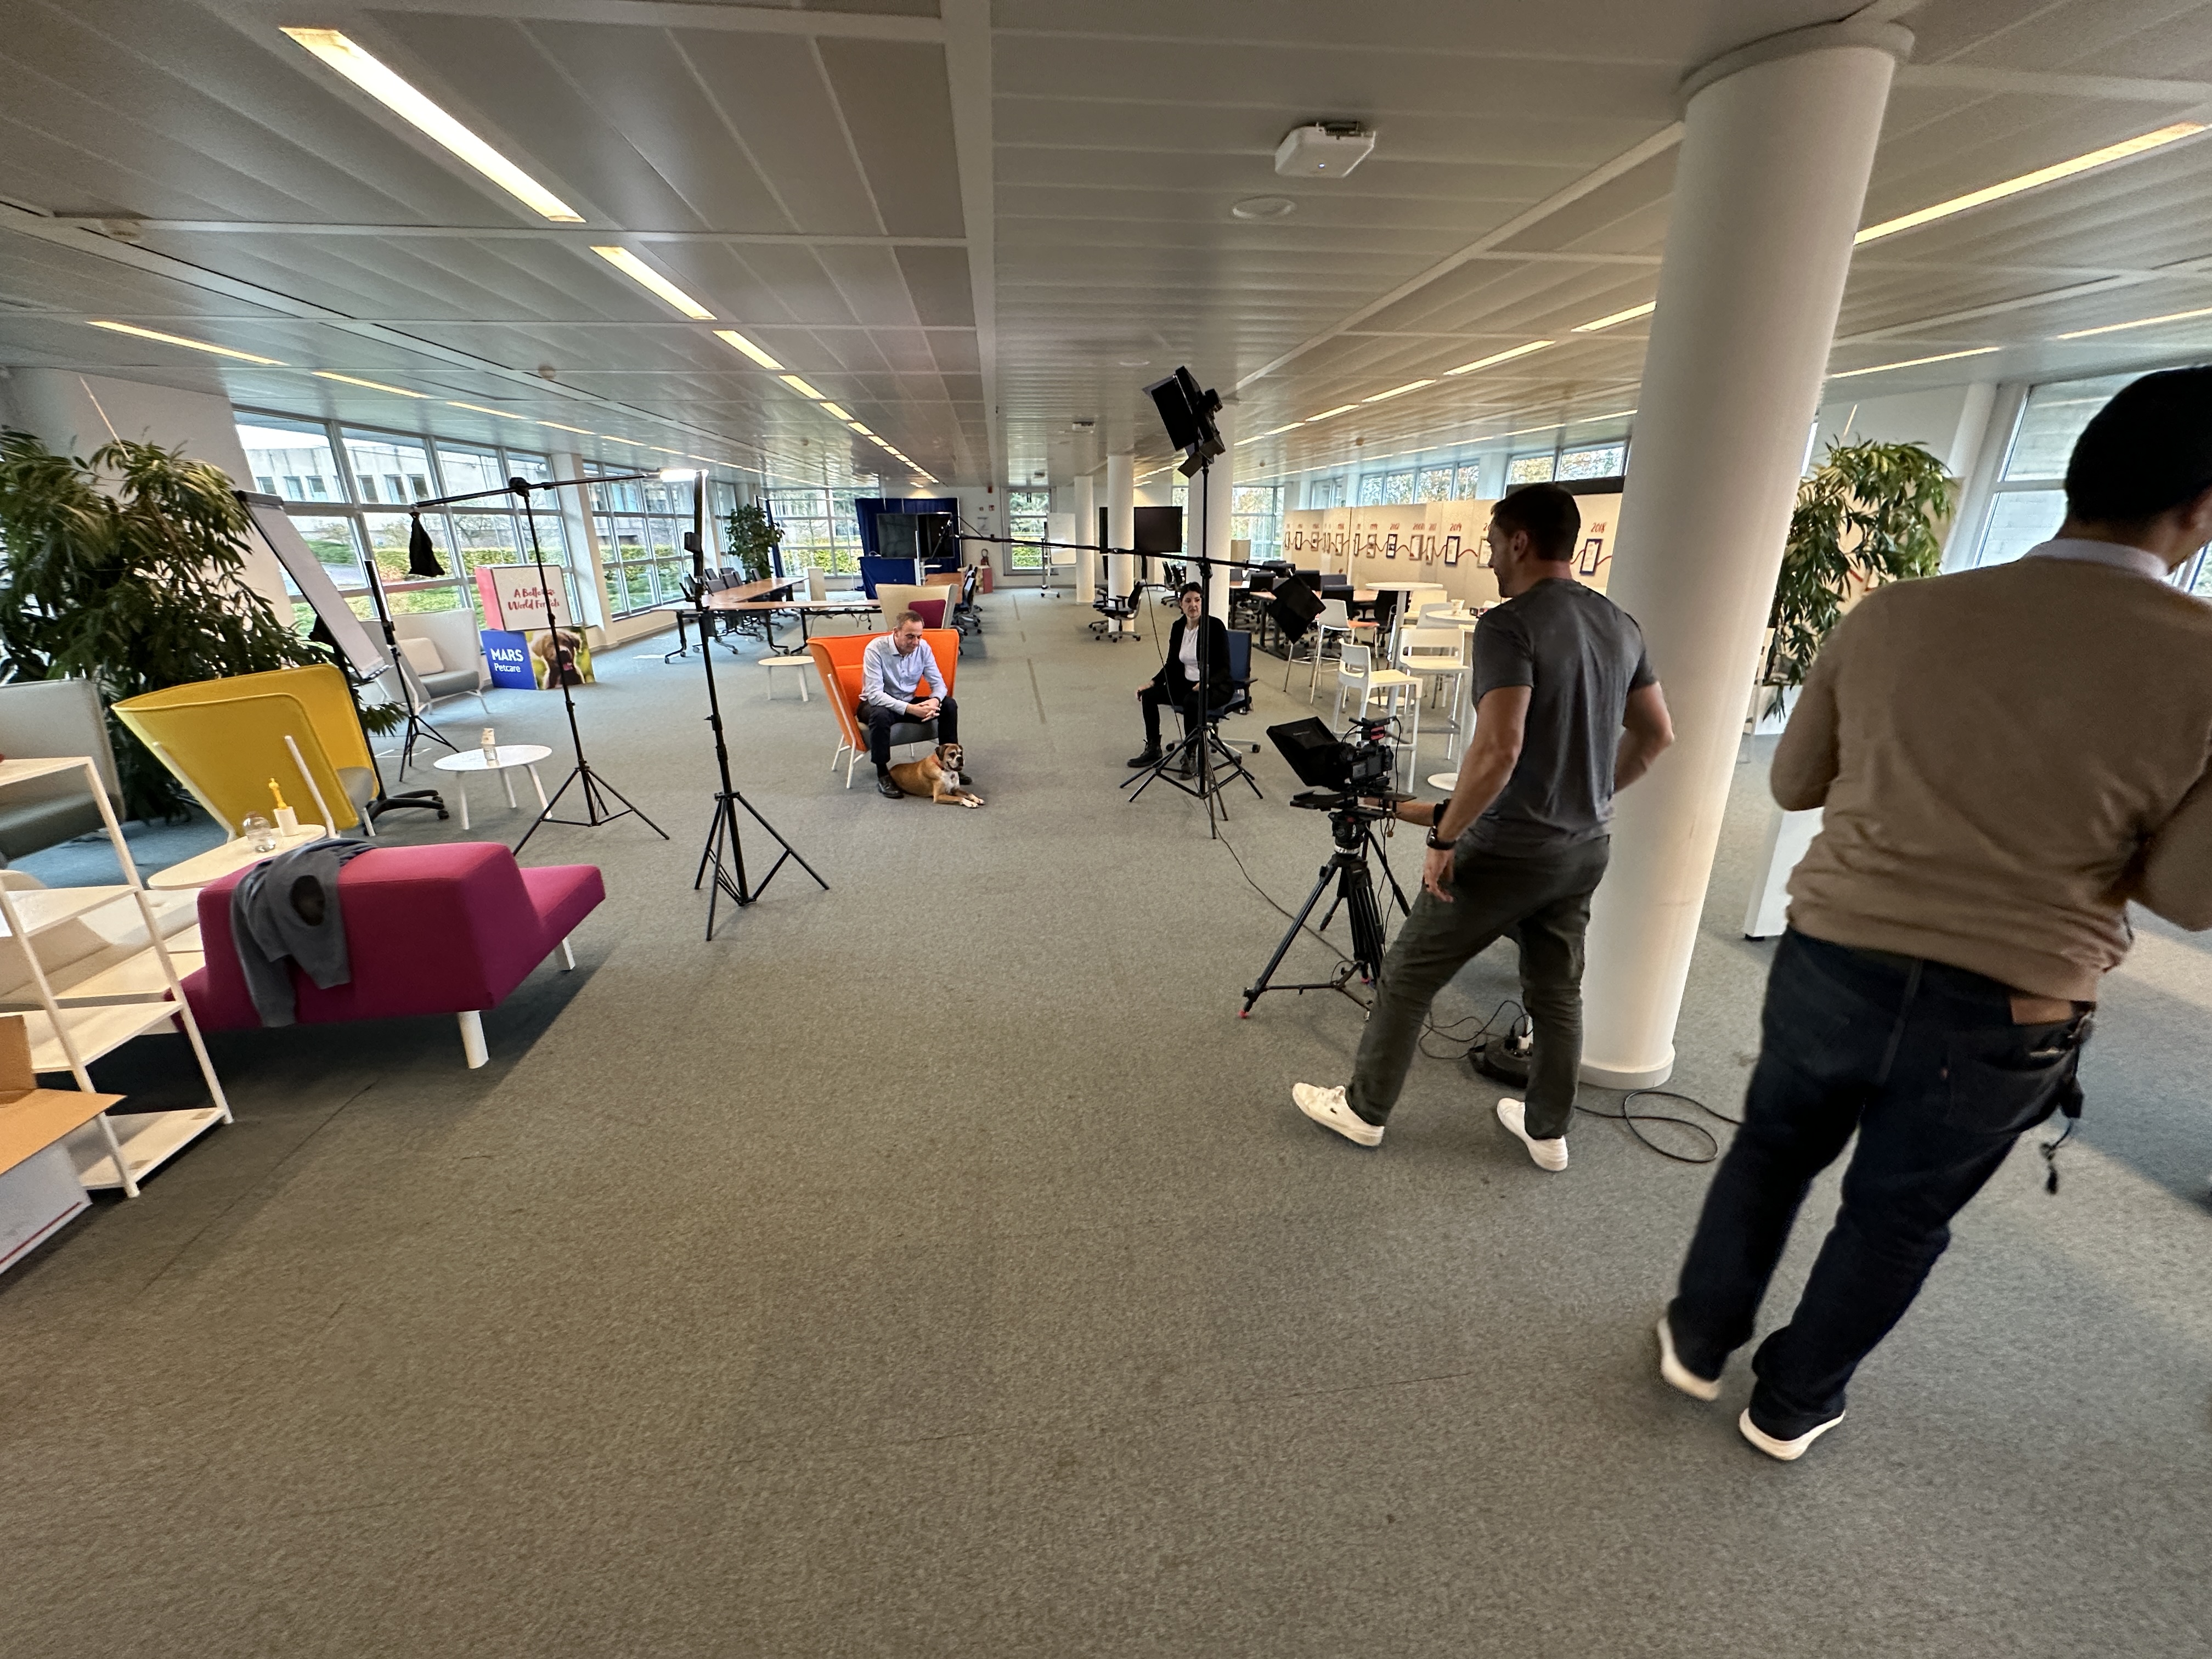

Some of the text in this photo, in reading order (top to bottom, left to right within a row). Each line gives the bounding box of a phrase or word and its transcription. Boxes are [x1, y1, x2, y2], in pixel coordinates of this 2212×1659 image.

[1590, 522, 1607, 533] 2018
[514, 589, 521, 598] A
[507, 599, 534, 611] World
[535, 600, 546, 608] For
[490, 648, 524, 662] MARS
[494, 663, 521, 673] Petcare
